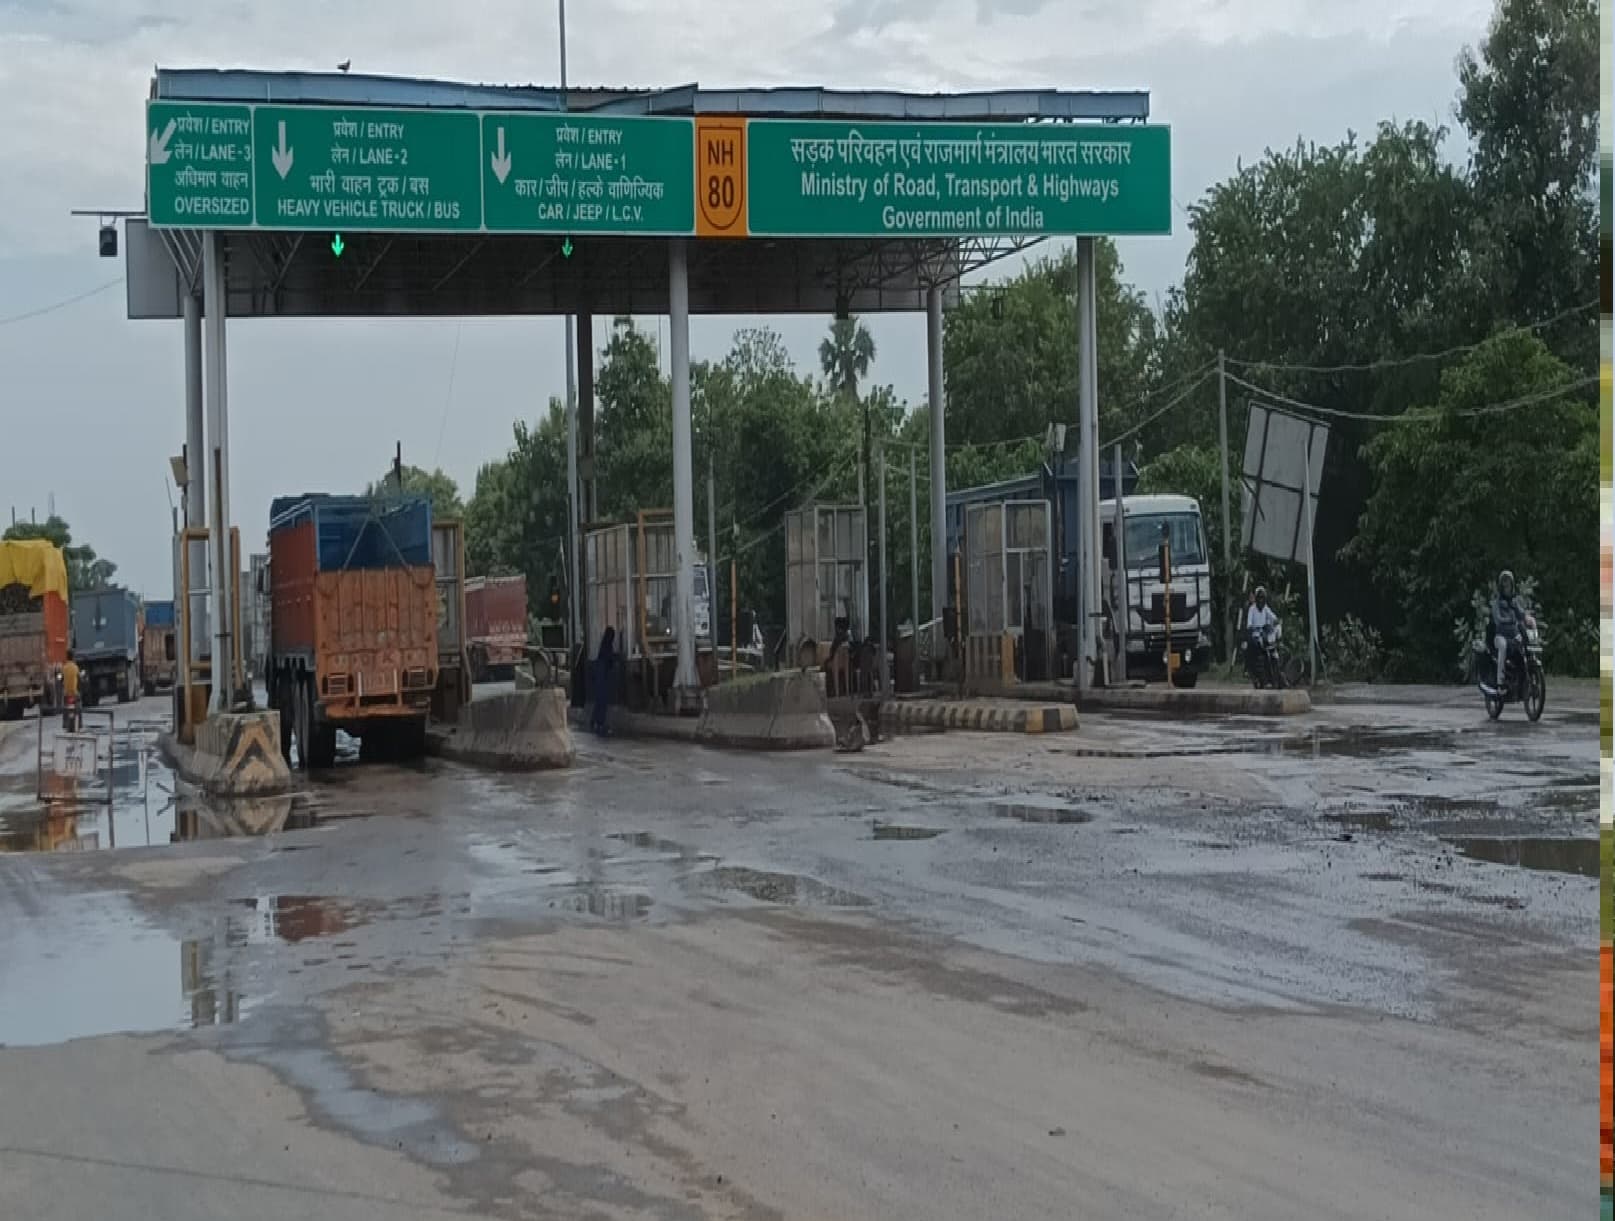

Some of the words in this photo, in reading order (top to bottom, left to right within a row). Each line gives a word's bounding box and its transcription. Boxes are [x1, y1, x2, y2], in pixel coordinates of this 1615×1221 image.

[177, 111, 204, 134] प्रवेश
[211, 118, 250, 134] ENTRY
[333, 115, 358, 138] प्रवेश
[367, 122, 405, 139] ENTRY
[556, 122, 580, 144] प्रवेश
[588, 128, 623, 145] ENTRY
[174, 139, 193, 159] लेन
[331, 142, 350, 165] लेन
[555, 146, 573, 169] लेन
[708, 139, 734, 167] NH
[790, 138, 834, 168] सड़क
[837, 129, 897, 166] परिवहन
[900, 131, 921, 168] एवं
[924, 130, 983, 164] राजमार्ग
[984, 131, 1039, 164] मंत्रालय
[1040, 139, 1078, 165] भारत
[1080, 141, 1132, 165] सरकार
[175, 165, 217, 188] अधिमाप
[221, 171, 249, 190] वाहन
[310, 168, 336, 193] भारी
[341, 175, 372, 195] वाहन
[377, 177, 400, 198] ट्रक
[409, 177, 430, 196] बस
[514, 179, 537, 197] कार
[545, 173, 569, 198] जीप
[801, 172, 868, 203] Ministry
[873, 172, 890, 196] of
[893, 172, 940, 200] Road,
[944, 173, 1023, 203] Transport
[1027, 173, 1038, 196] &
[1043, 173, 1119, 203] Highways
[708, 175, 734, 210] 80
[174, 196, 249, 214] OVERSIZED
[277, 199, 320, 217] HEAVY
[323, 200, 378, 217] VEHICLE
[381, 201, 424, 219] TRUCK
[434, 201, 460, 219] BUS
[538, 203, 564, 220] CAR
[572, 204, 602, 220] JEEP
[882, 205, 980, 229] Government
[985, 205, 1001, 229] of
[1005, 205, 1044, 229] India
